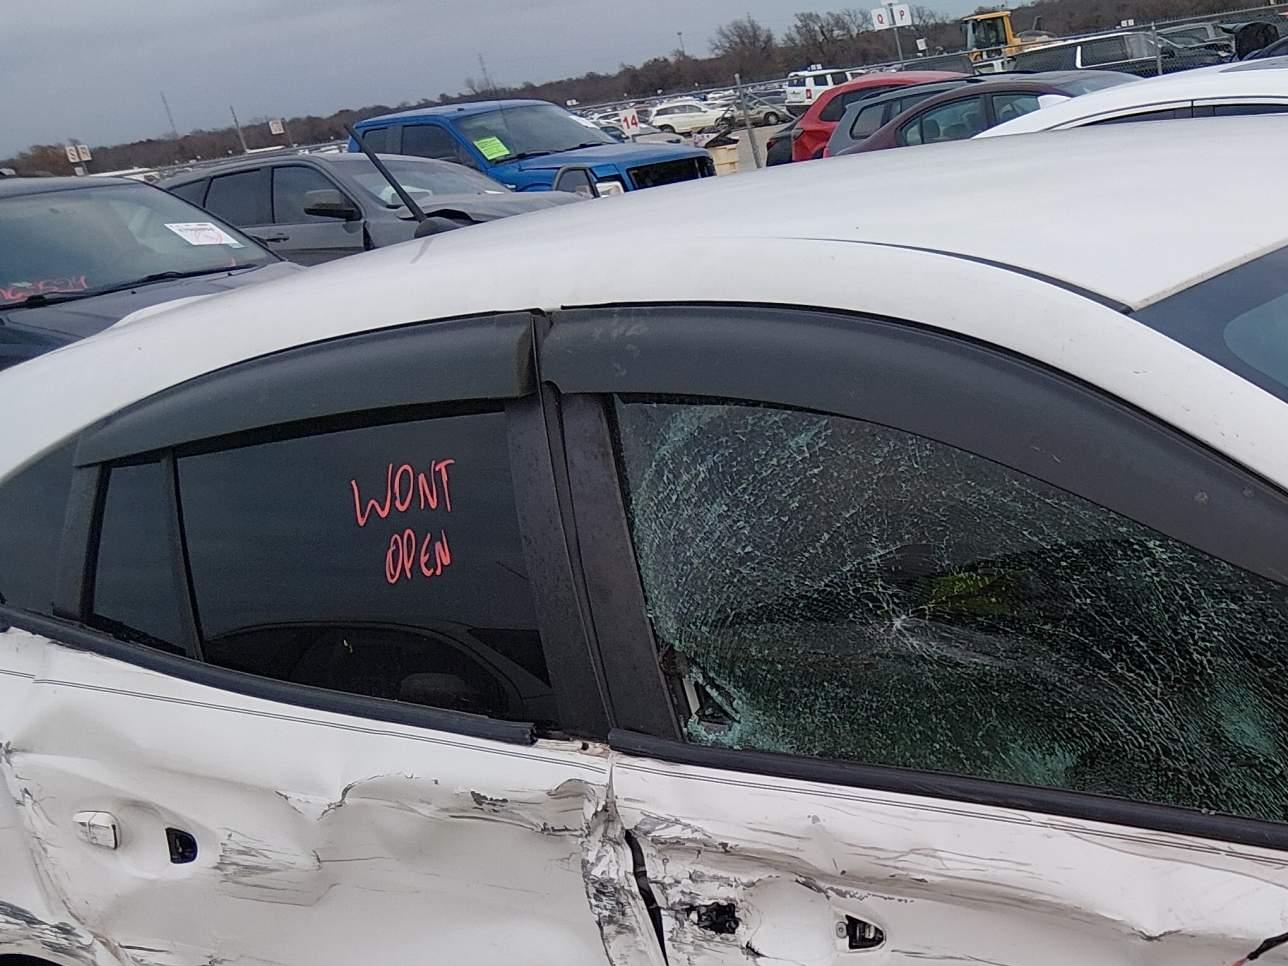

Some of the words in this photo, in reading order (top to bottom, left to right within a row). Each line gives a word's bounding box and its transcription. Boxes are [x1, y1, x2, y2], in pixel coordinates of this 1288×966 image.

[623, 114, 638, 129] 14
[350, 458, 456, 527] WONT
[385, 527, 452, 584] OPEN
